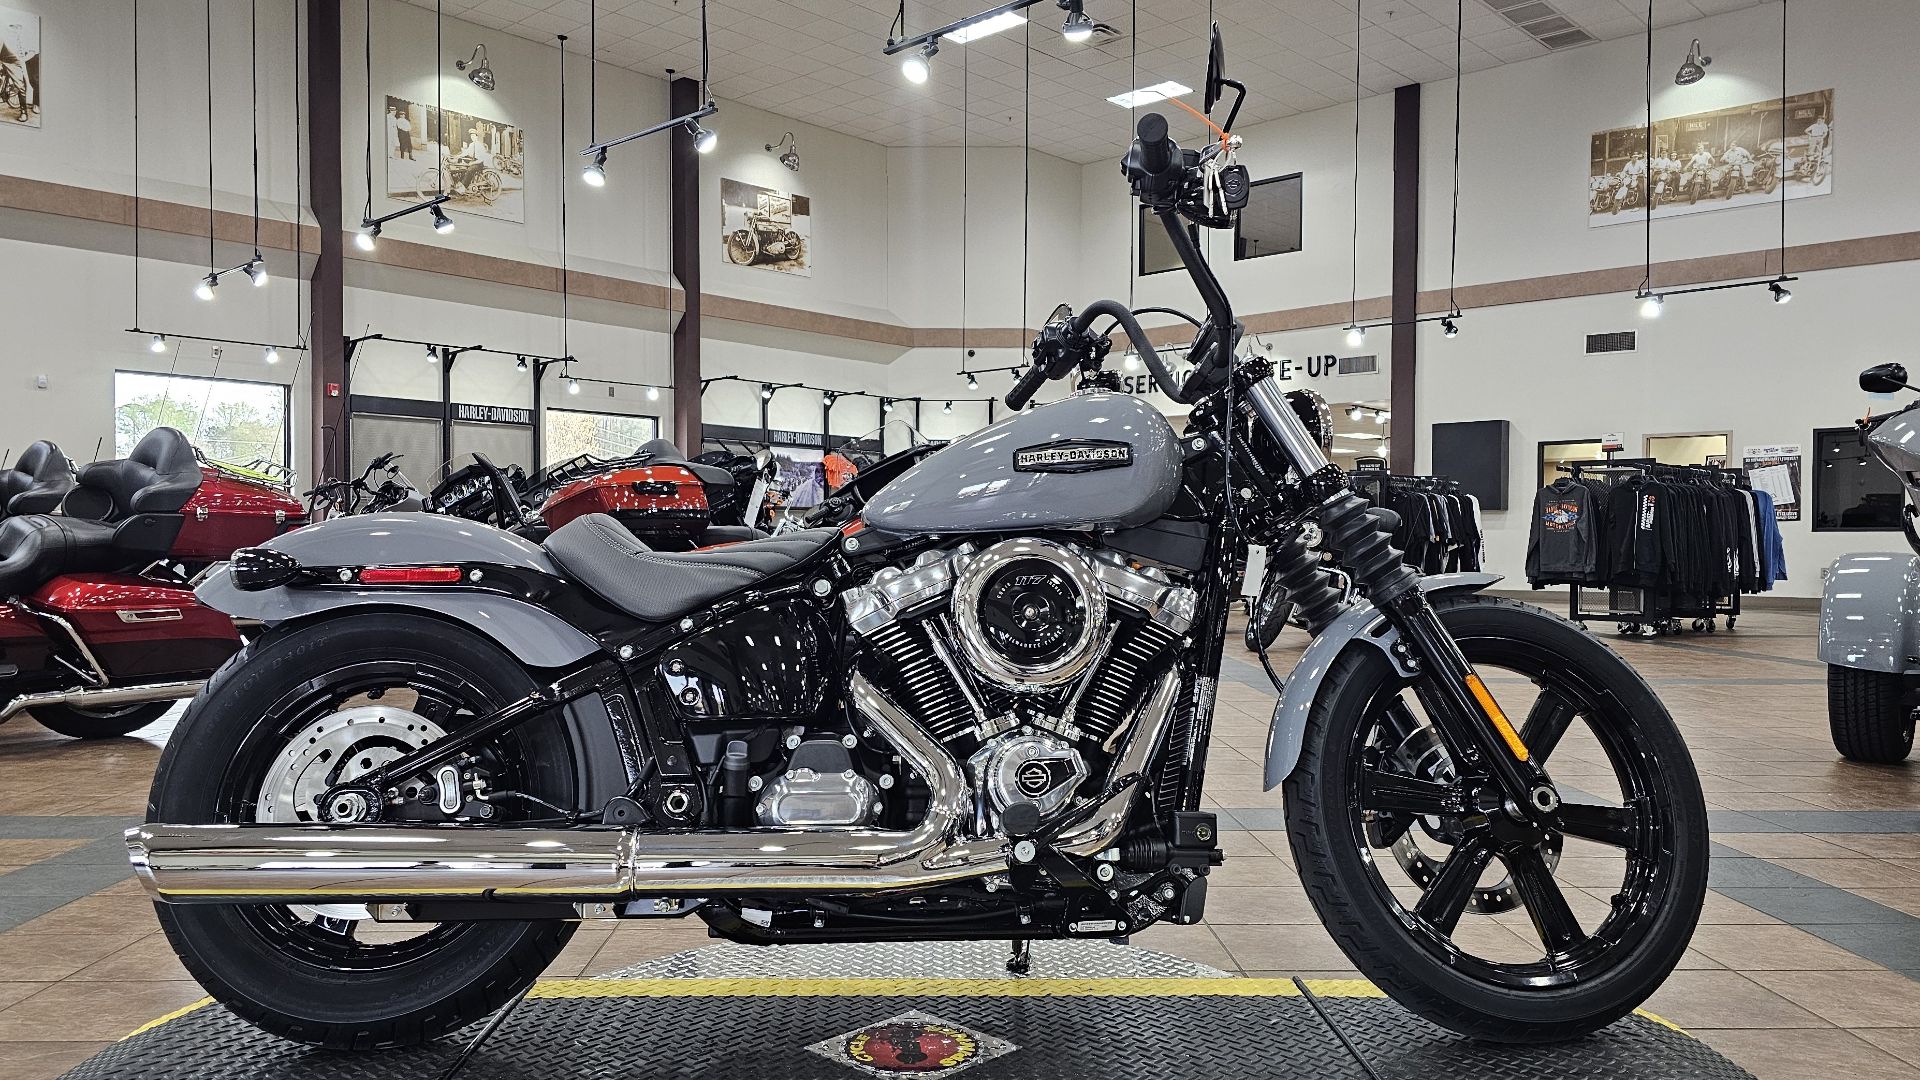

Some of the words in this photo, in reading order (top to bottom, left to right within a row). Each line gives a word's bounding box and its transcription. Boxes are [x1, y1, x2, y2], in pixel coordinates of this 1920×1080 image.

[458, 404, 529, 424] HARLEY-DAVIDSON
[773, 431, 822, 446] HARLEY-DAVIDSON
[1020, 449, 1129, 463] HARLEY-DAVIDSON
[1014, 574, 1047, 586] 117
